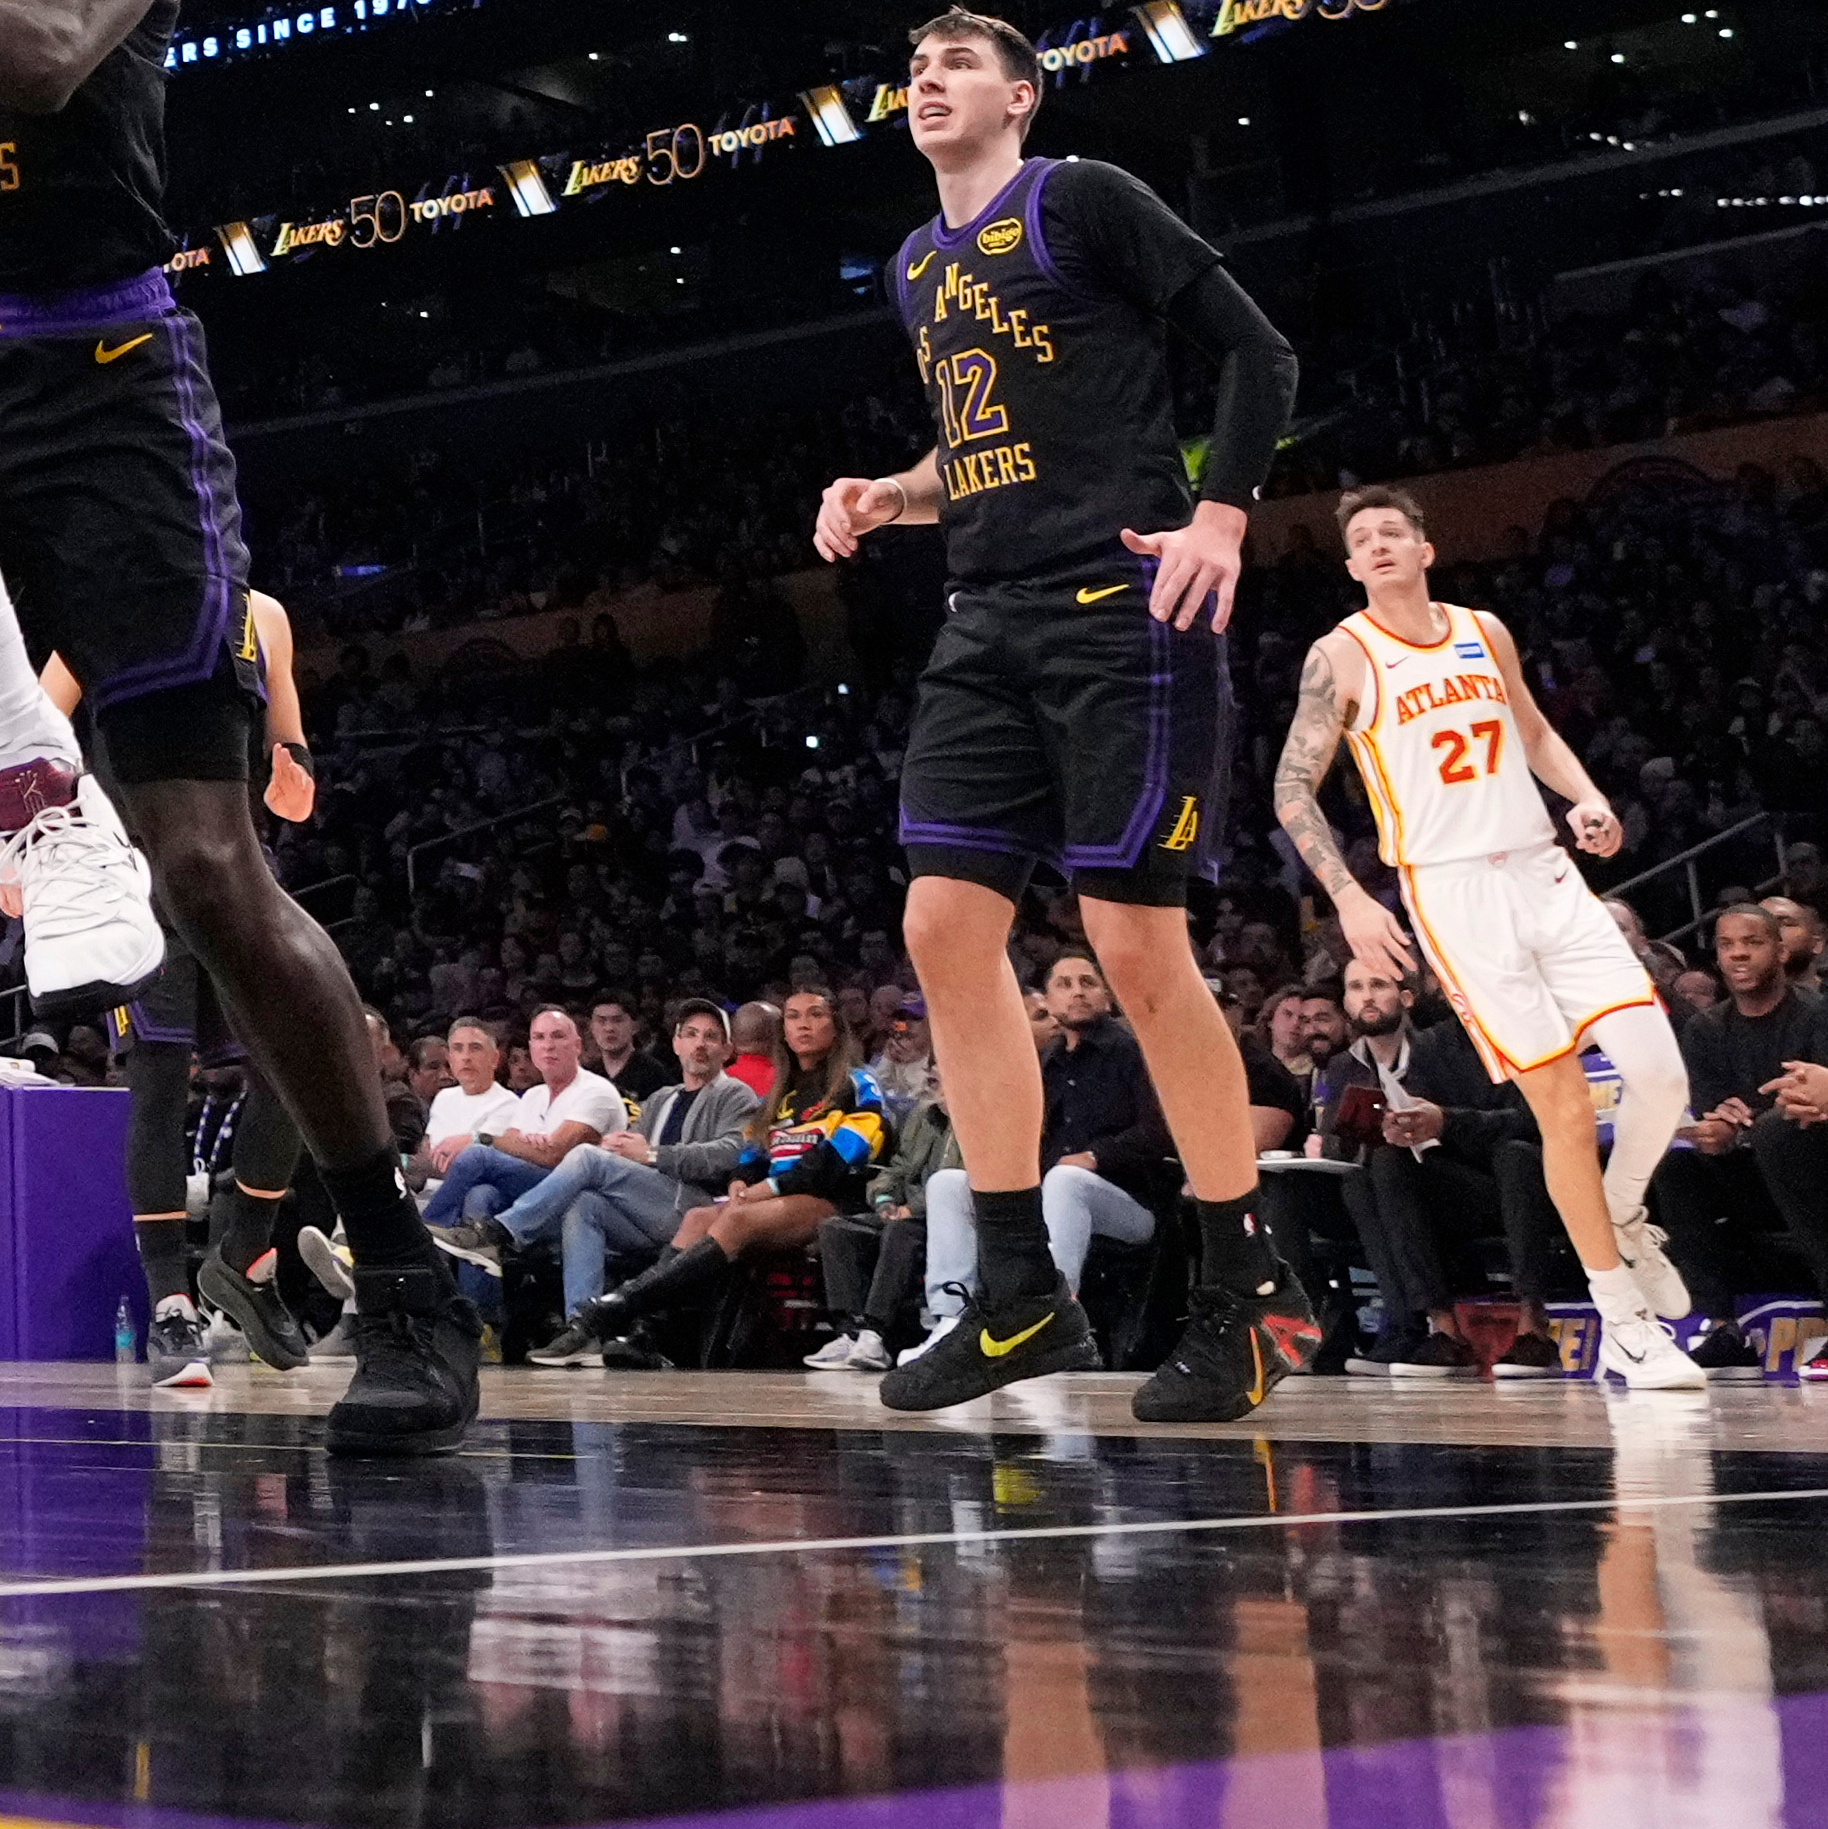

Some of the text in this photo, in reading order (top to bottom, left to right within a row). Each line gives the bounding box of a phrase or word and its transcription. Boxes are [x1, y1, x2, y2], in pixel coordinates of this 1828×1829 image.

[236, 6, 336, 50] SINCE
[563, 117, 795, 197] LAKERS 50 TOYOTA
[270, 187, 495, 257] LAKERS 50 TOYOTA
[981, 223, 1020, 247] bibigo
[934, 261, 1055, 363] ANGELES
[935, 347, 1009, 449] 12
[943, 442, 1037, 501] LAKERS
[1395, 674, 1507, 726] ATLANTA
[1431, 719, 1505, 785] 27
